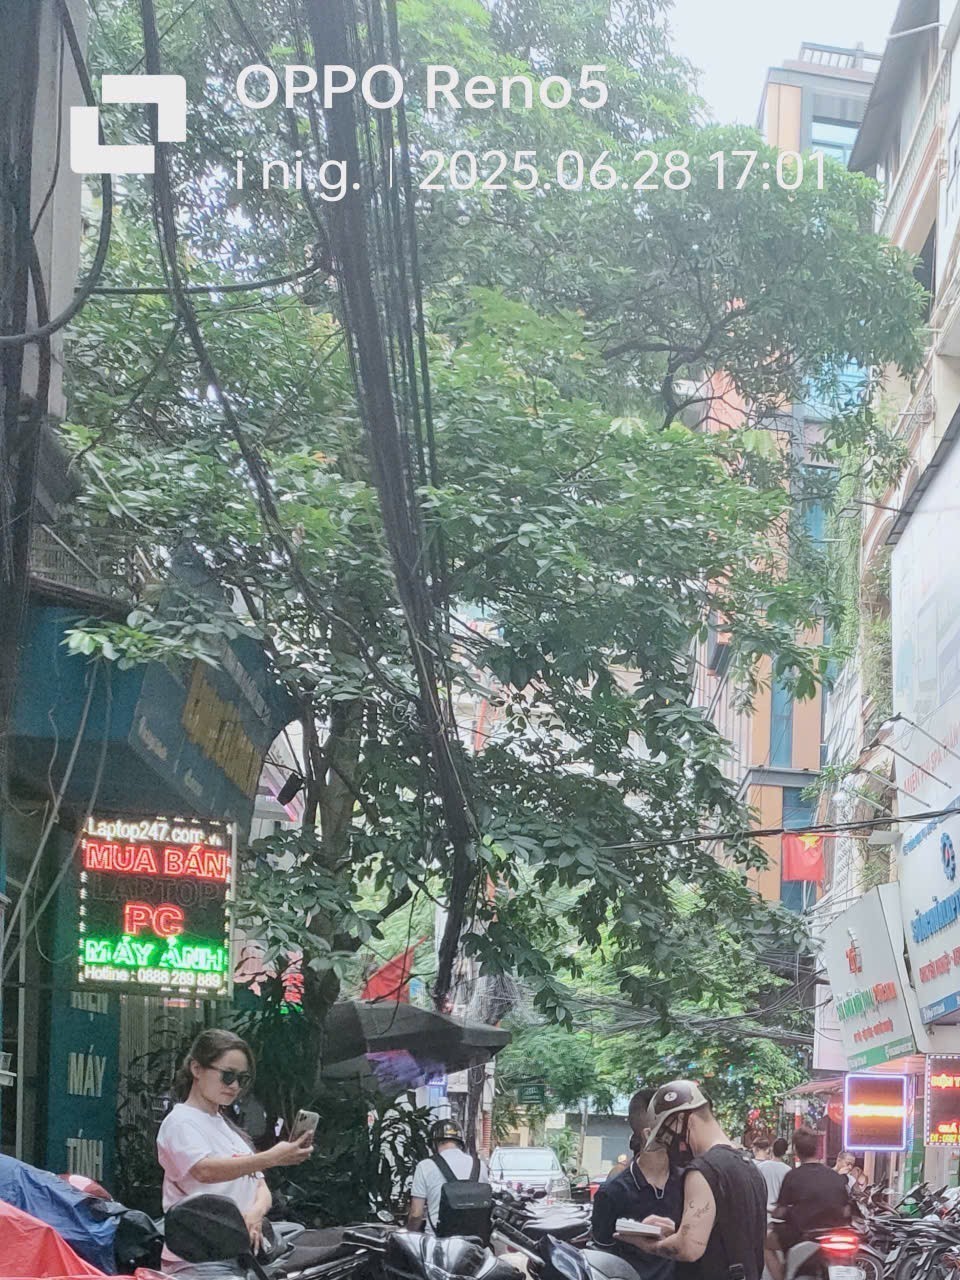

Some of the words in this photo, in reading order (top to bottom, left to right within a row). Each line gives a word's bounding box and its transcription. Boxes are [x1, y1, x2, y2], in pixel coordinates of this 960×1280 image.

[85, 842, 157, 873] MUA
[164, 845, 228, 879] BÁN
[92, 875, 219, 907] LAPTOP
[124, 904, 184, 938] PC
[85, 936, 154, 966] MÁY
[159, 936, 224, 971] ẢNH
[84, 965, 129, 982] Hotline
[68, 1044, 107, 1097] MÁY
[66, 1128, 104, 1181] TÍNH
